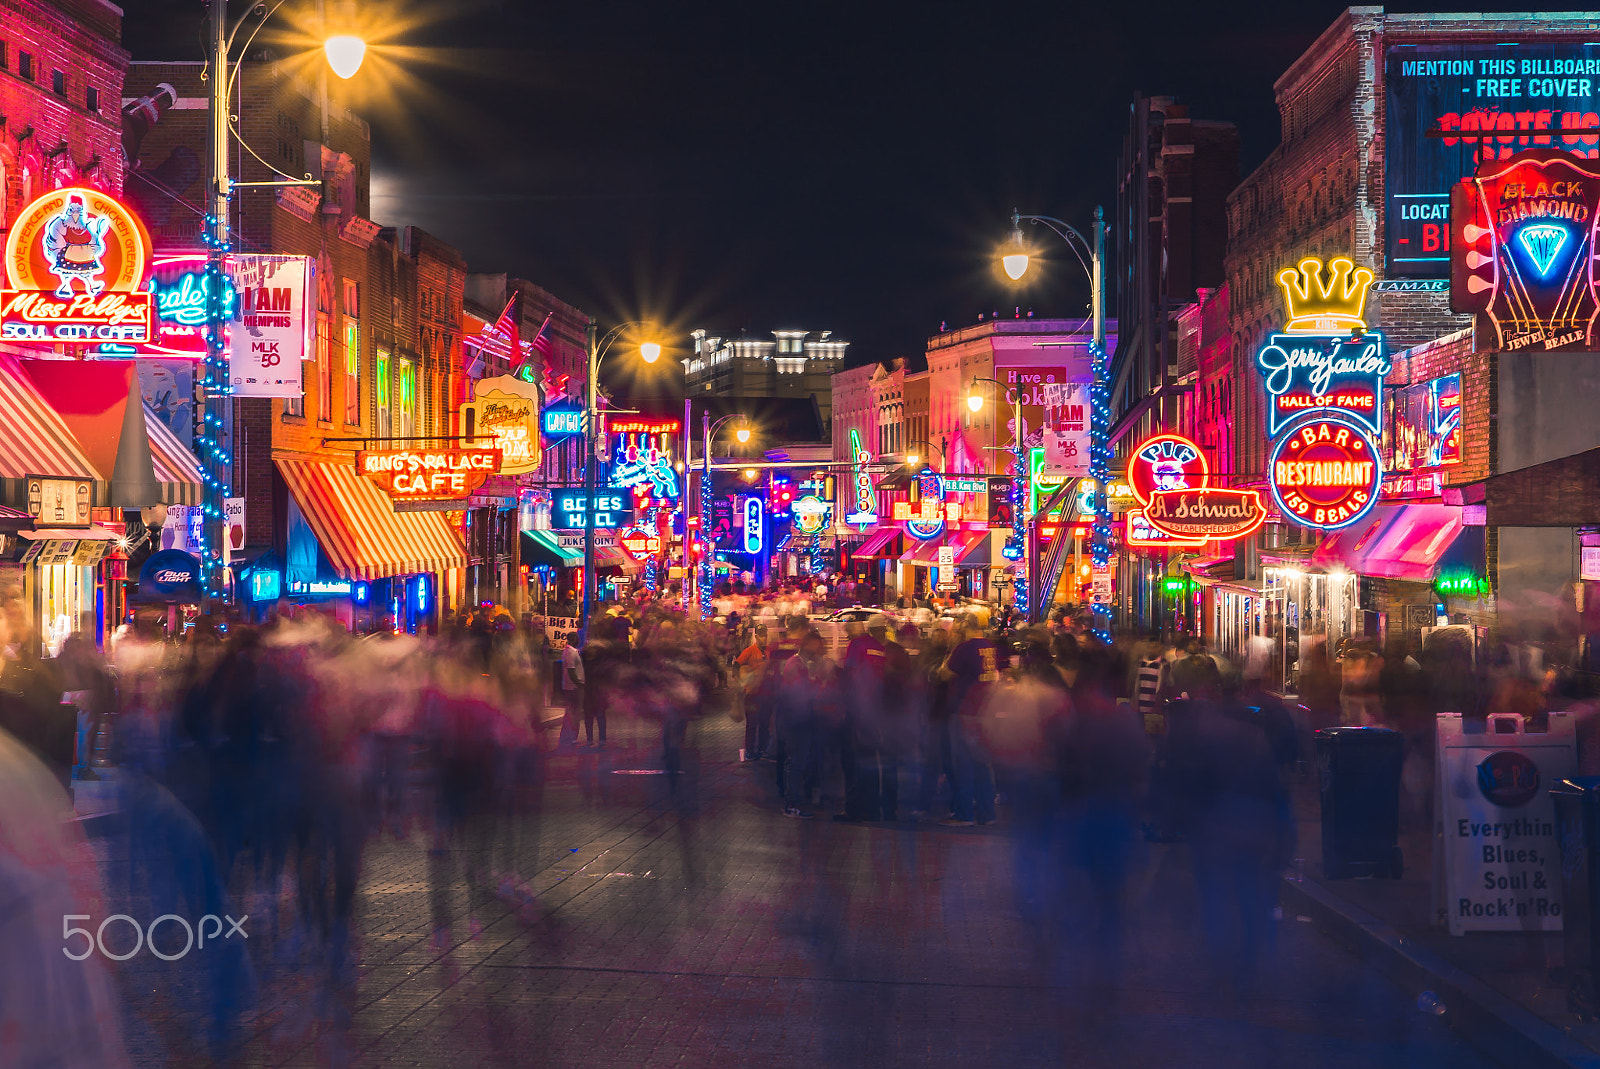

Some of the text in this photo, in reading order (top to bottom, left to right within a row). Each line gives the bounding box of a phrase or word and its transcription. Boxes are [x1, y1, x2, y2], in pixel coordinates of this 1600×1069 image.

[1402, 60, 1474, 76] MENTION
[1479, 59, 1516, 75] THIS
[1476, 79, 1591, 97] FREE COVER
[1438, 109, 1554, 146] COYOTE
[1504, 181, 1584, 199] BLACK
[1402, 204, 1450, 219] LOCAT
[1497, 199, 1589, 225] DIAMOND
[19, 208, 44, 244] PEACE
[42, 197, 64, 213] AND
[94, 200, 129, 237] CHICKEN
[122, 237, 137, 284] GREASE
[1376, 281, 1445, 291] LAMAR
[2, 293, 67, 318] Miss
[256, 287, 292, 311] AM
[243, 315, 291, 328] MEMPHIS
[1315, 319, 1338, 330] KING
[2, 322, 54, 340] SOUL
[55, 324, 96, 339] CITY
[97, 325, 146, 340] CAFE
[1503, 329, 1519, 340] The
[251, 342, 279, 353] MLK
[1506, 331, 1545, 351] JEWEL
[1545, 330, 1586, 351] BEALE
[261, 352, 281, 368] 50
[1259, 337, 1392, 396] Jerry Lawler
[1046, 374, 1055, 384] a
[1280, 396, 1373, 407] HALL OF FAME
[1060, 405, 1084, 421] AM
[547, 413, 579, 431] CARGO
[1052, 423, 1084, 432] MEMPHIS
[1301, 424, 1350, 447] BAR
[1058, 440, 1077, 449] MLK
[1064, 448, 1078, 458] 50
[424, 454, 493, 471] PALACE
[1276, 461, 1374, 486] RESTAURANT
[393, 473, 466, 493] CAFE
[959, 481, 971, 491] King
[226, 503, 242, 515] Patio
[1174, 494, 1256, 518] Schwab
[1283, 490, 1369, 523] 159 BEALE
[1169, 523, 1242, 533] ESTABLISHED 1876
[562, 538, 584, 546] JUKE
[595, 537, 615, 545] OINT
[940, 555, 952, 563] 25
[549, 617, 566, 628] Big
[1483, 845, 1545, 866] Blues,
[1484, 872, 1547, 890] Soul &
